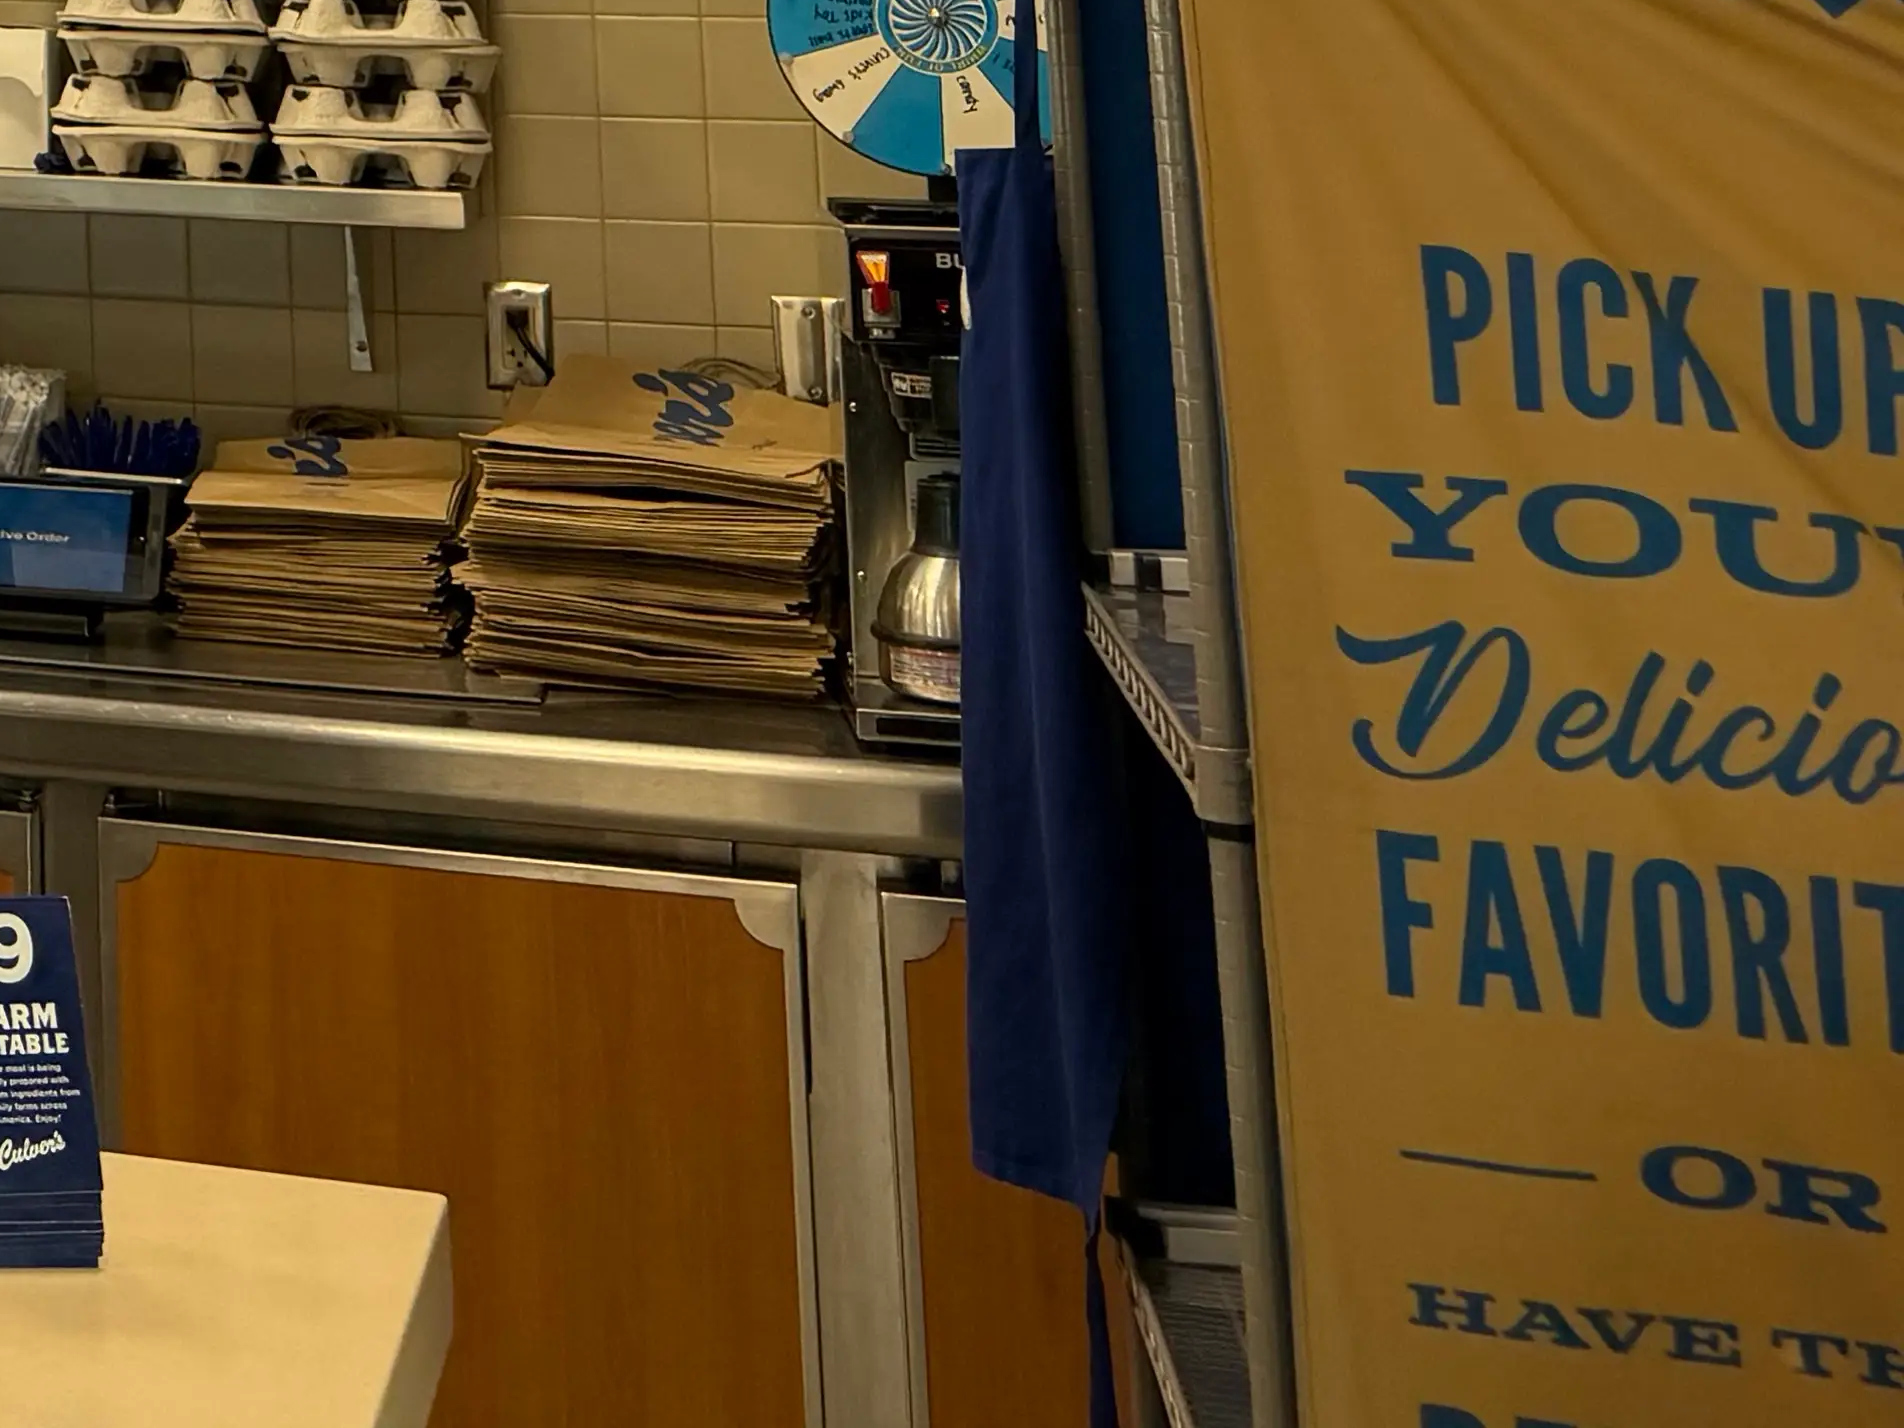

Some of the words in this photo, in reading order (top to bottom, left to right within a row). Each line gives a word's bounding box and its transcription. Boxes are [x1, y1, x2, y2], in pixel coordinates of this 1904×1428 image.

[1418, 243, 1739, 434] PICK
[24, 532, 69, 542] Order
[1343, 467, 1904, 600] YOU
[1641, 1145, 1888, 1233] OR
[1406, 1282, 1742, 1369] HAVE
